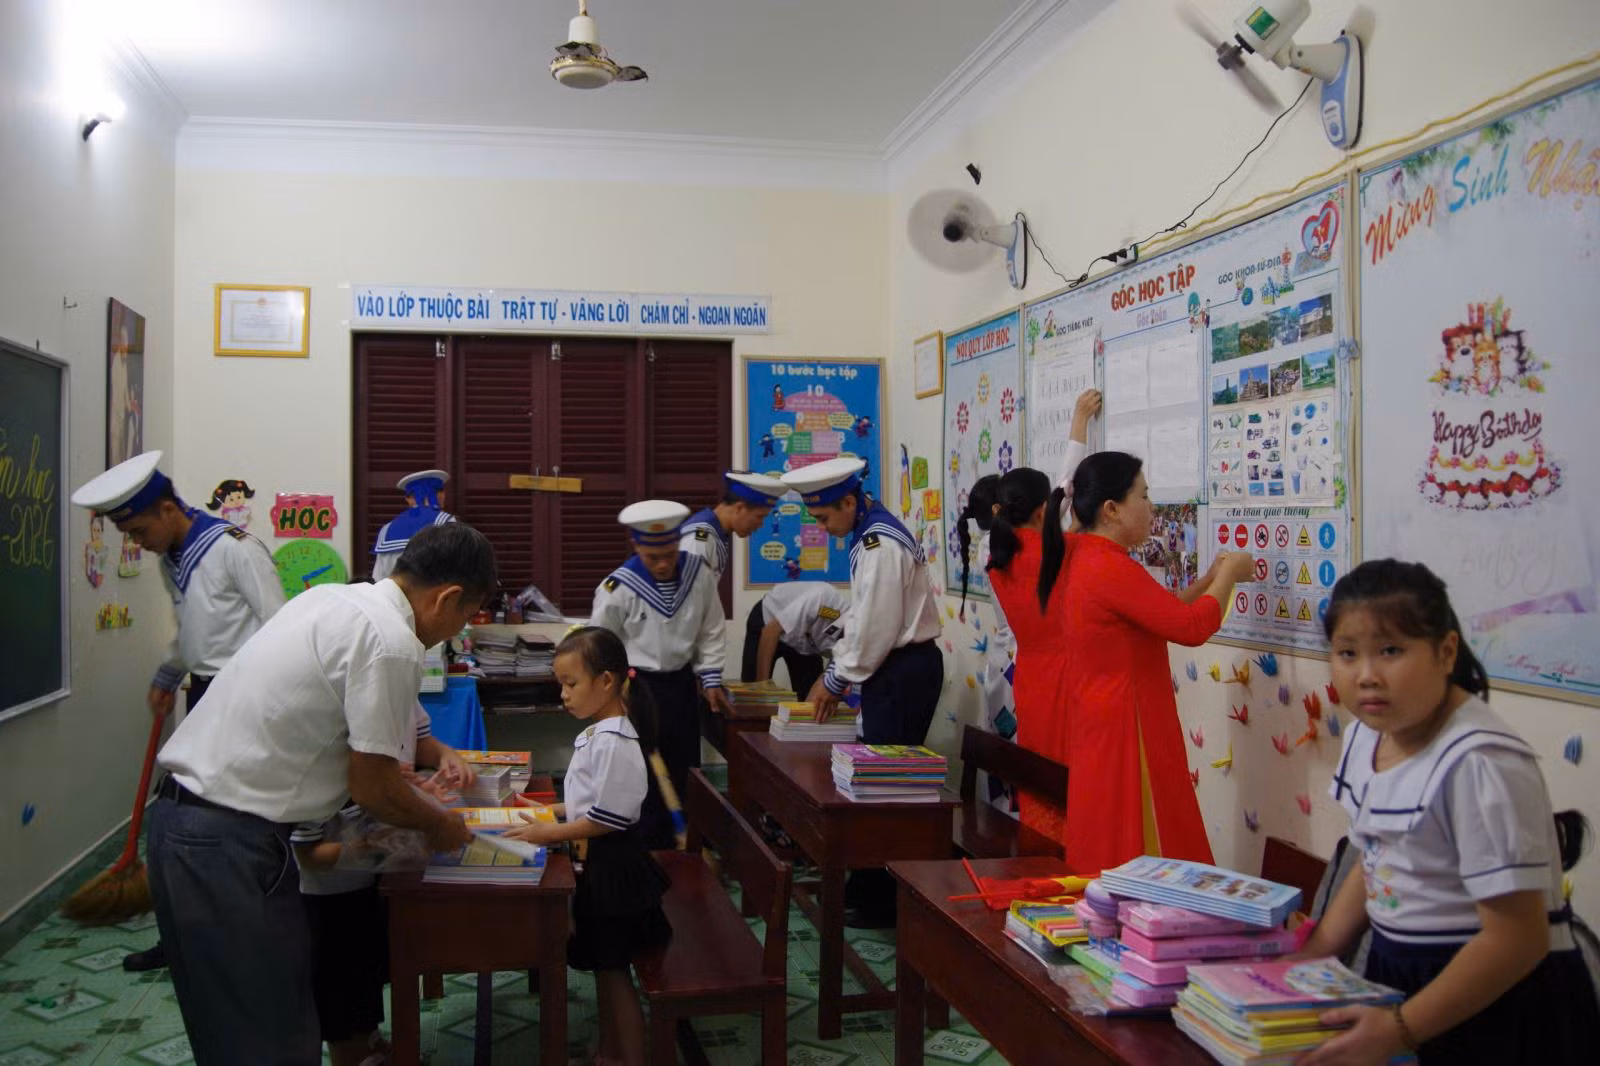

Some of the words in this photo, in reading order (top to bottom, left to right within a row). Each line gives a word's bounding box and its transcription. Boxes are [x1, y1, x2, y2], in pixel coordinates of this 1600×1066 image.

[1365, 184, 1434, 266] Mừng
[1448, 143, 1509, 213] Sinh
[1525, 137, 1600, 211] Nhậ
[1111, 283, 1135, 311] GÓC
[1138, 275, 1164, 304] HỌC
[1168, 263, 1195, 293] TẬP
[357, 290, 384, 317] VÀO
[388, 291, 415, 318] LỚP
[419, 292, 463, 323] THUỘC
[467, 293, 490, 320] BÀI
[501, 295, 536, 324] TRẬT
[540, 298, 558, 325] TỰ
[570, 297, 605, 322] VÂNG
[608, 298, 629, 323] LỜI
[672, 298, 689, 325] CHỈ
[698, 305, 731, 326] NGOAN
[996, 326, 1010, 348] HỌC
[771, 364, 785, 376] 10
[787, 364, 815, 376] bước
[817, 365, 837, 380] học
[839, 365, 858, 381] tập
[807, 384, 825, 397] 10
[1432, 410, 1480, 459] Happy
